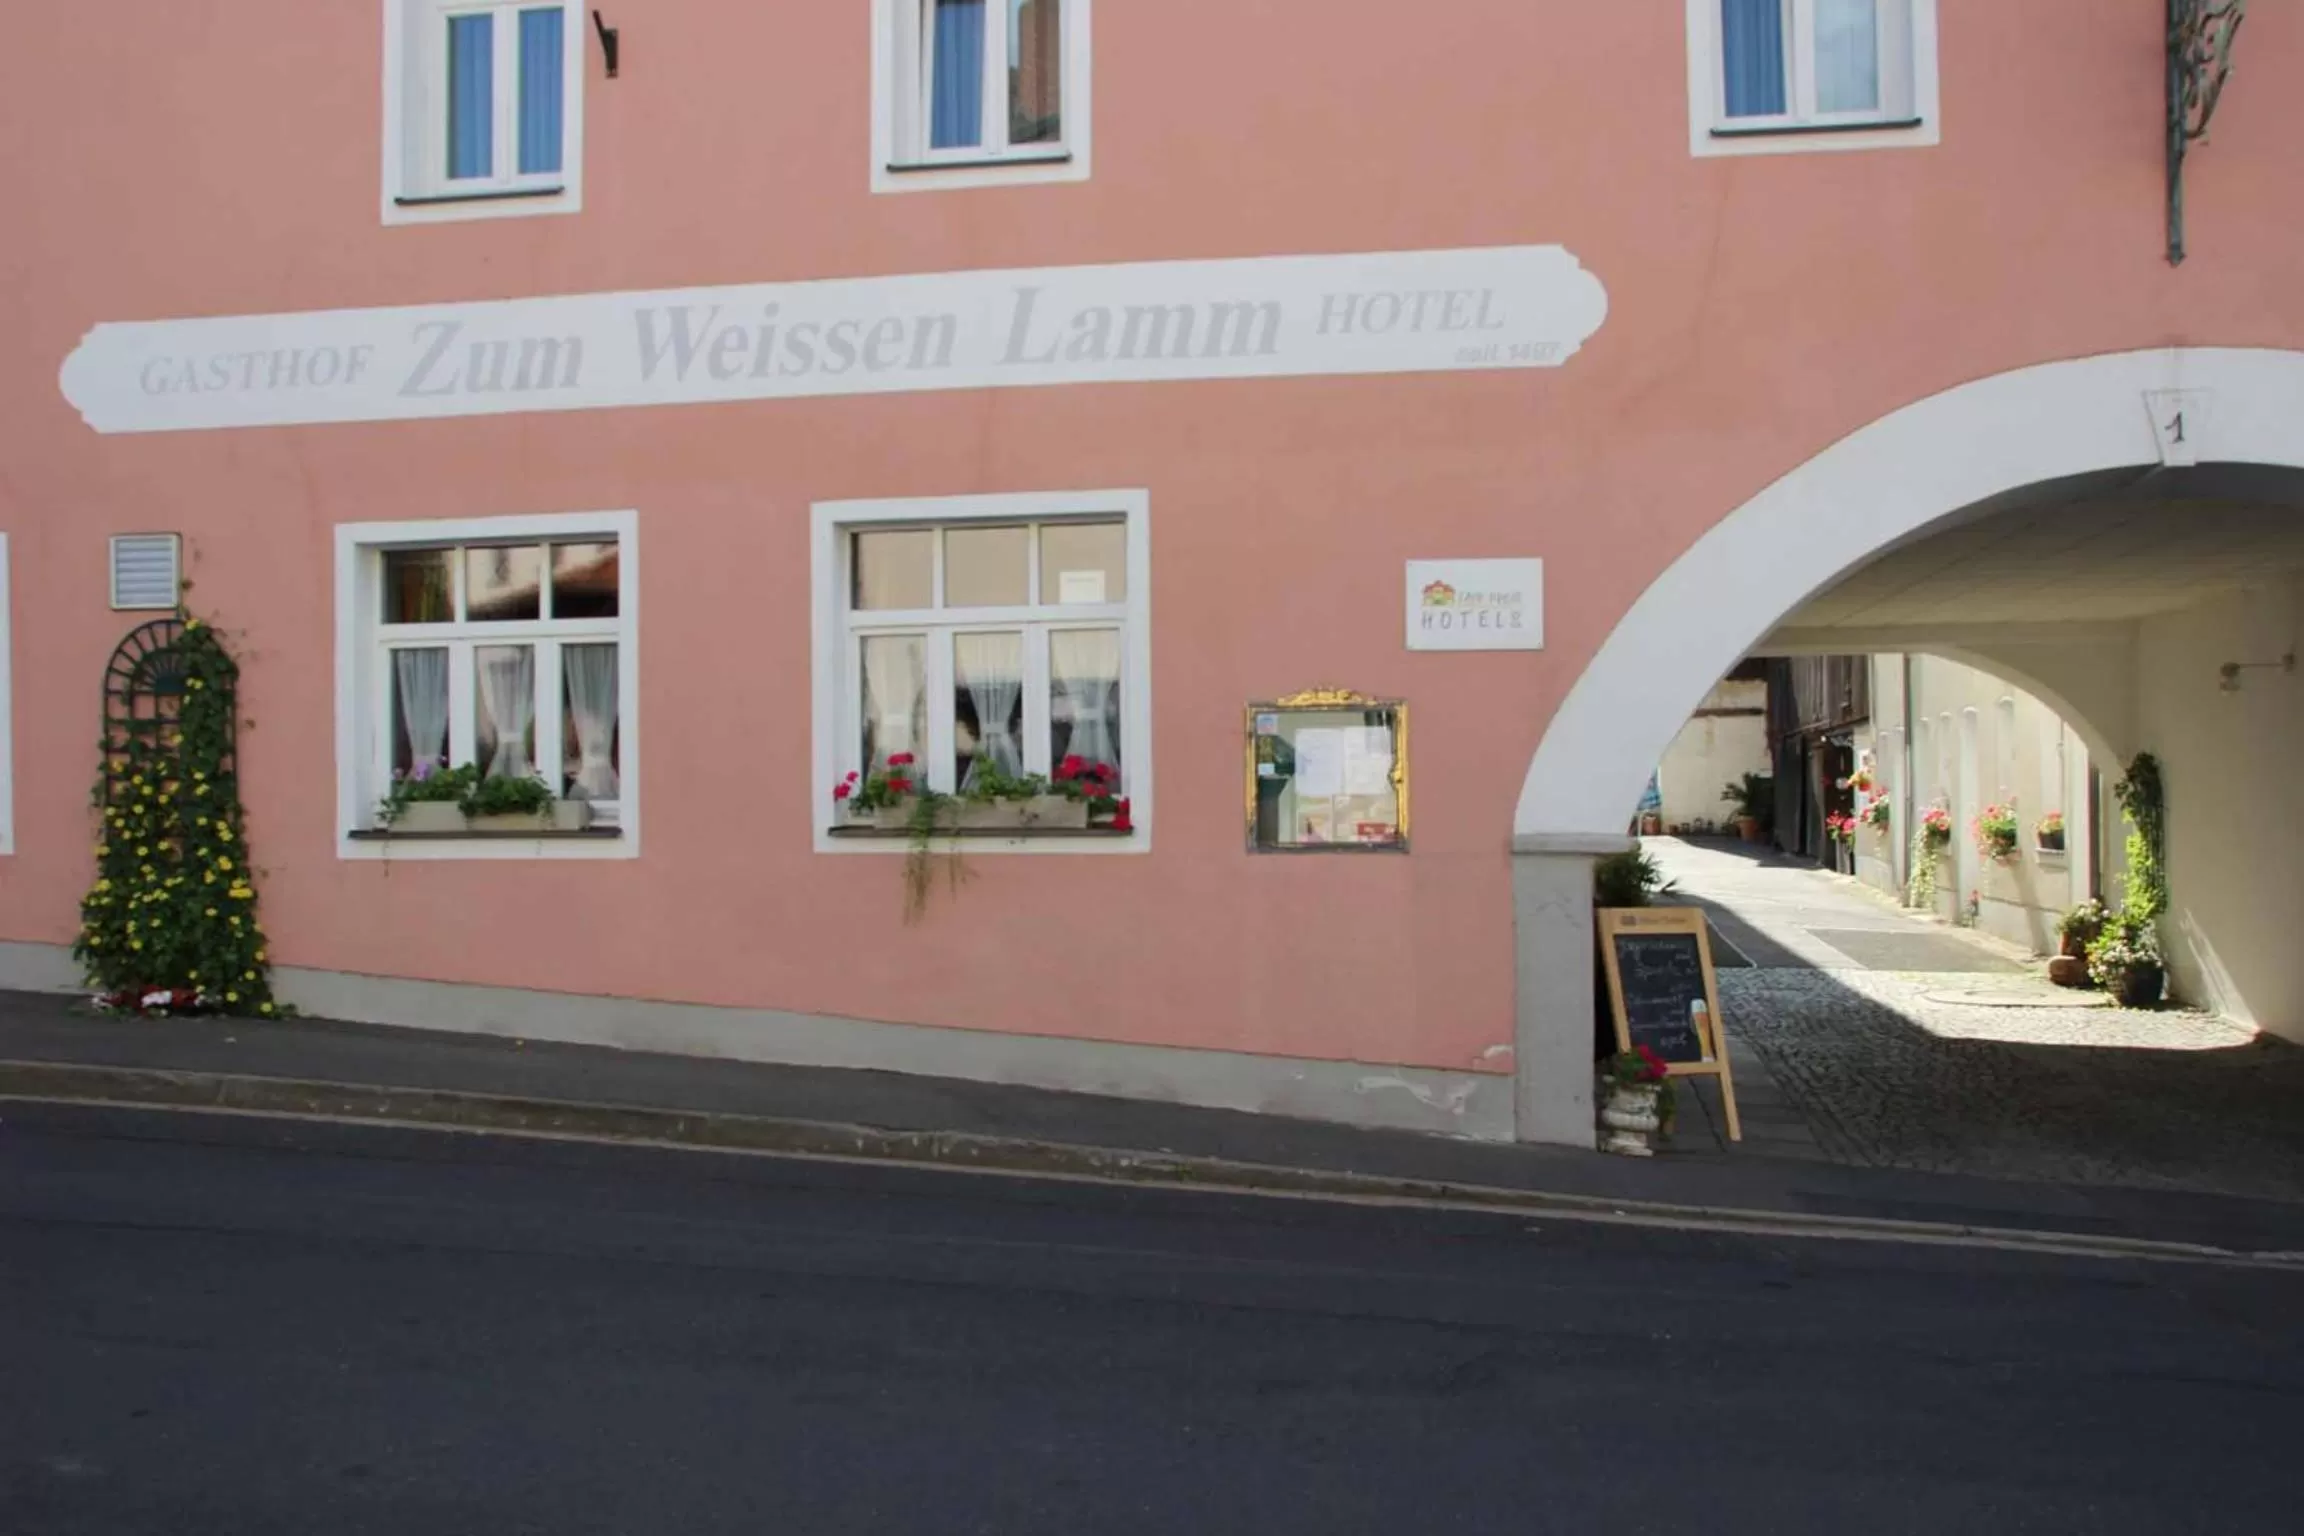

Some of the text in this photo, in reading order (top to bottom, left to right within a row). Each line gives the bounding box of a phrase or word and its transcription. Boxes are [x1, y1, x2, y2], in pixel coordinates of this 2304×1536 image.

[140, 286, 1504, 397] GASTHOF Zum Weissen Lamm HOTEL
[2164, 411, 2185, 444] 1
